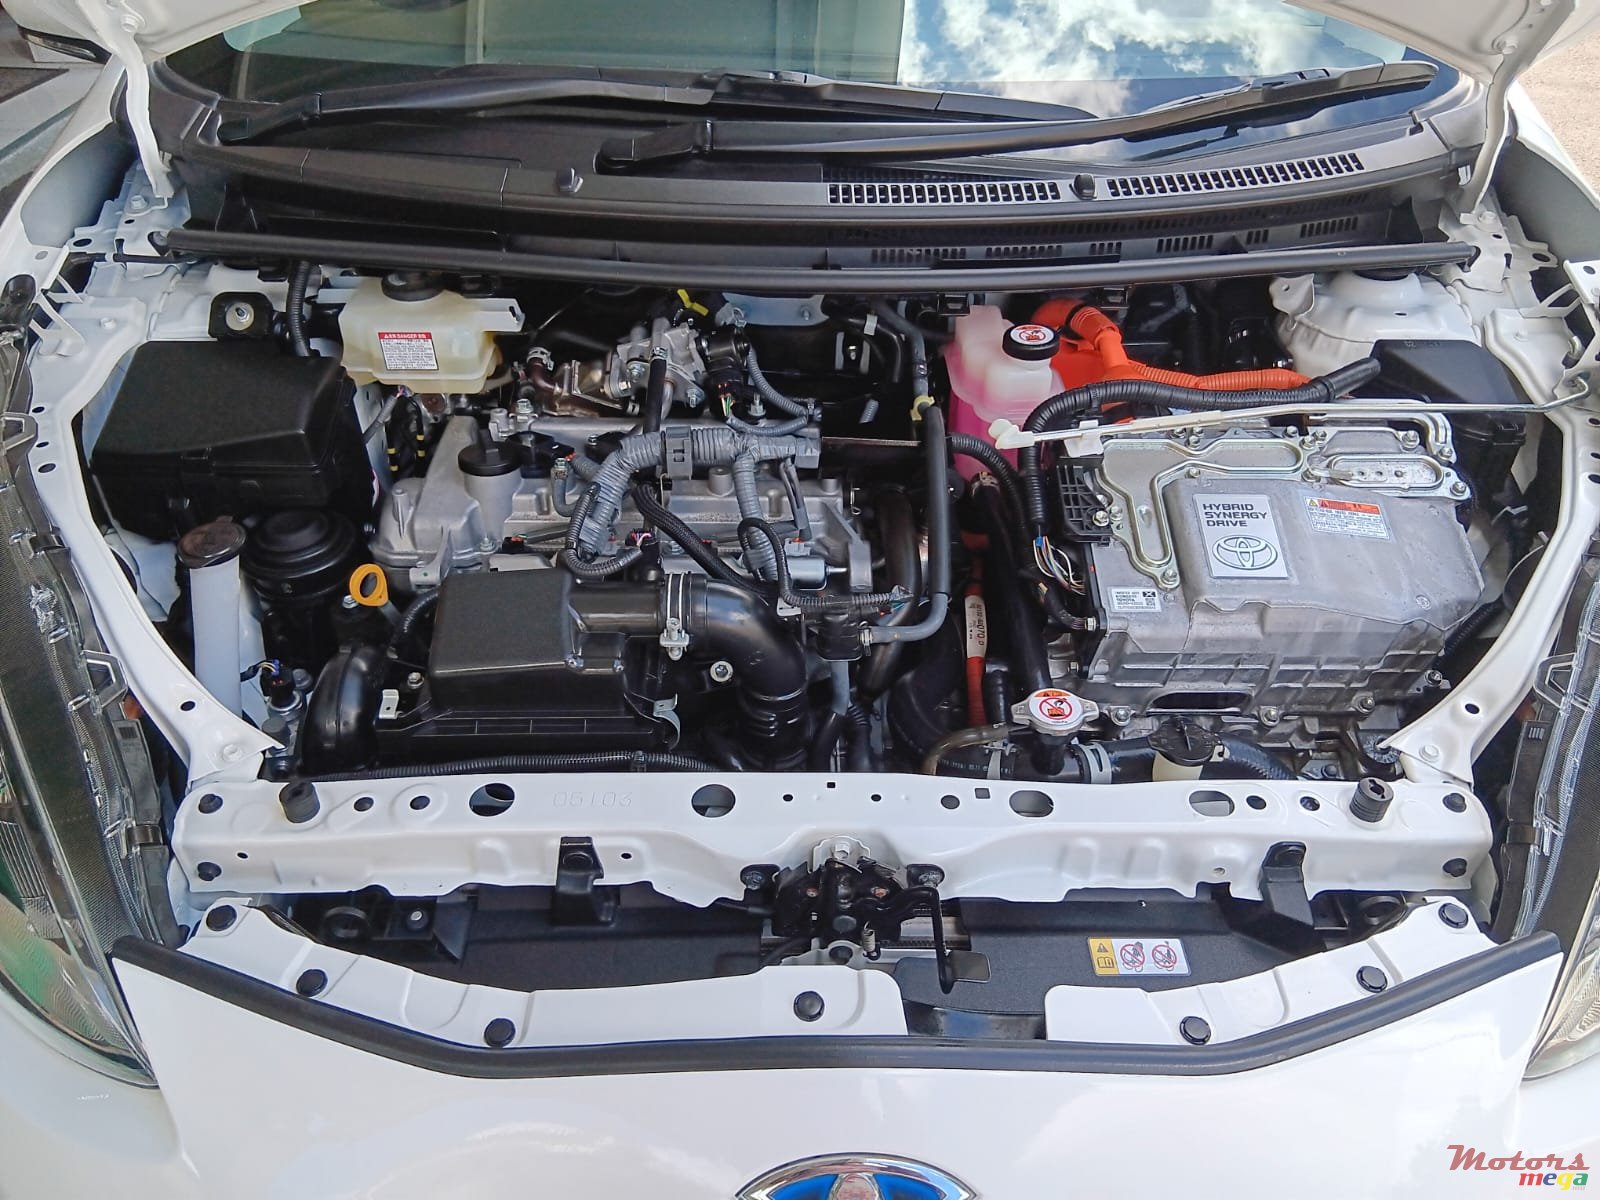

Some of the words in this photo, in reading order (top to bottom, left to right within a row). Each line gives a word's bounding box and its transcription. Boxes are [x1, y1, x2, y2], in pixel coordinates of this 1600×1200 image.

[1202, 503, 1254, 511] HYBRID
[1204, 511, 1267, 519] SYNERGY
[1206, 519, 1248, 527] DRIVE
